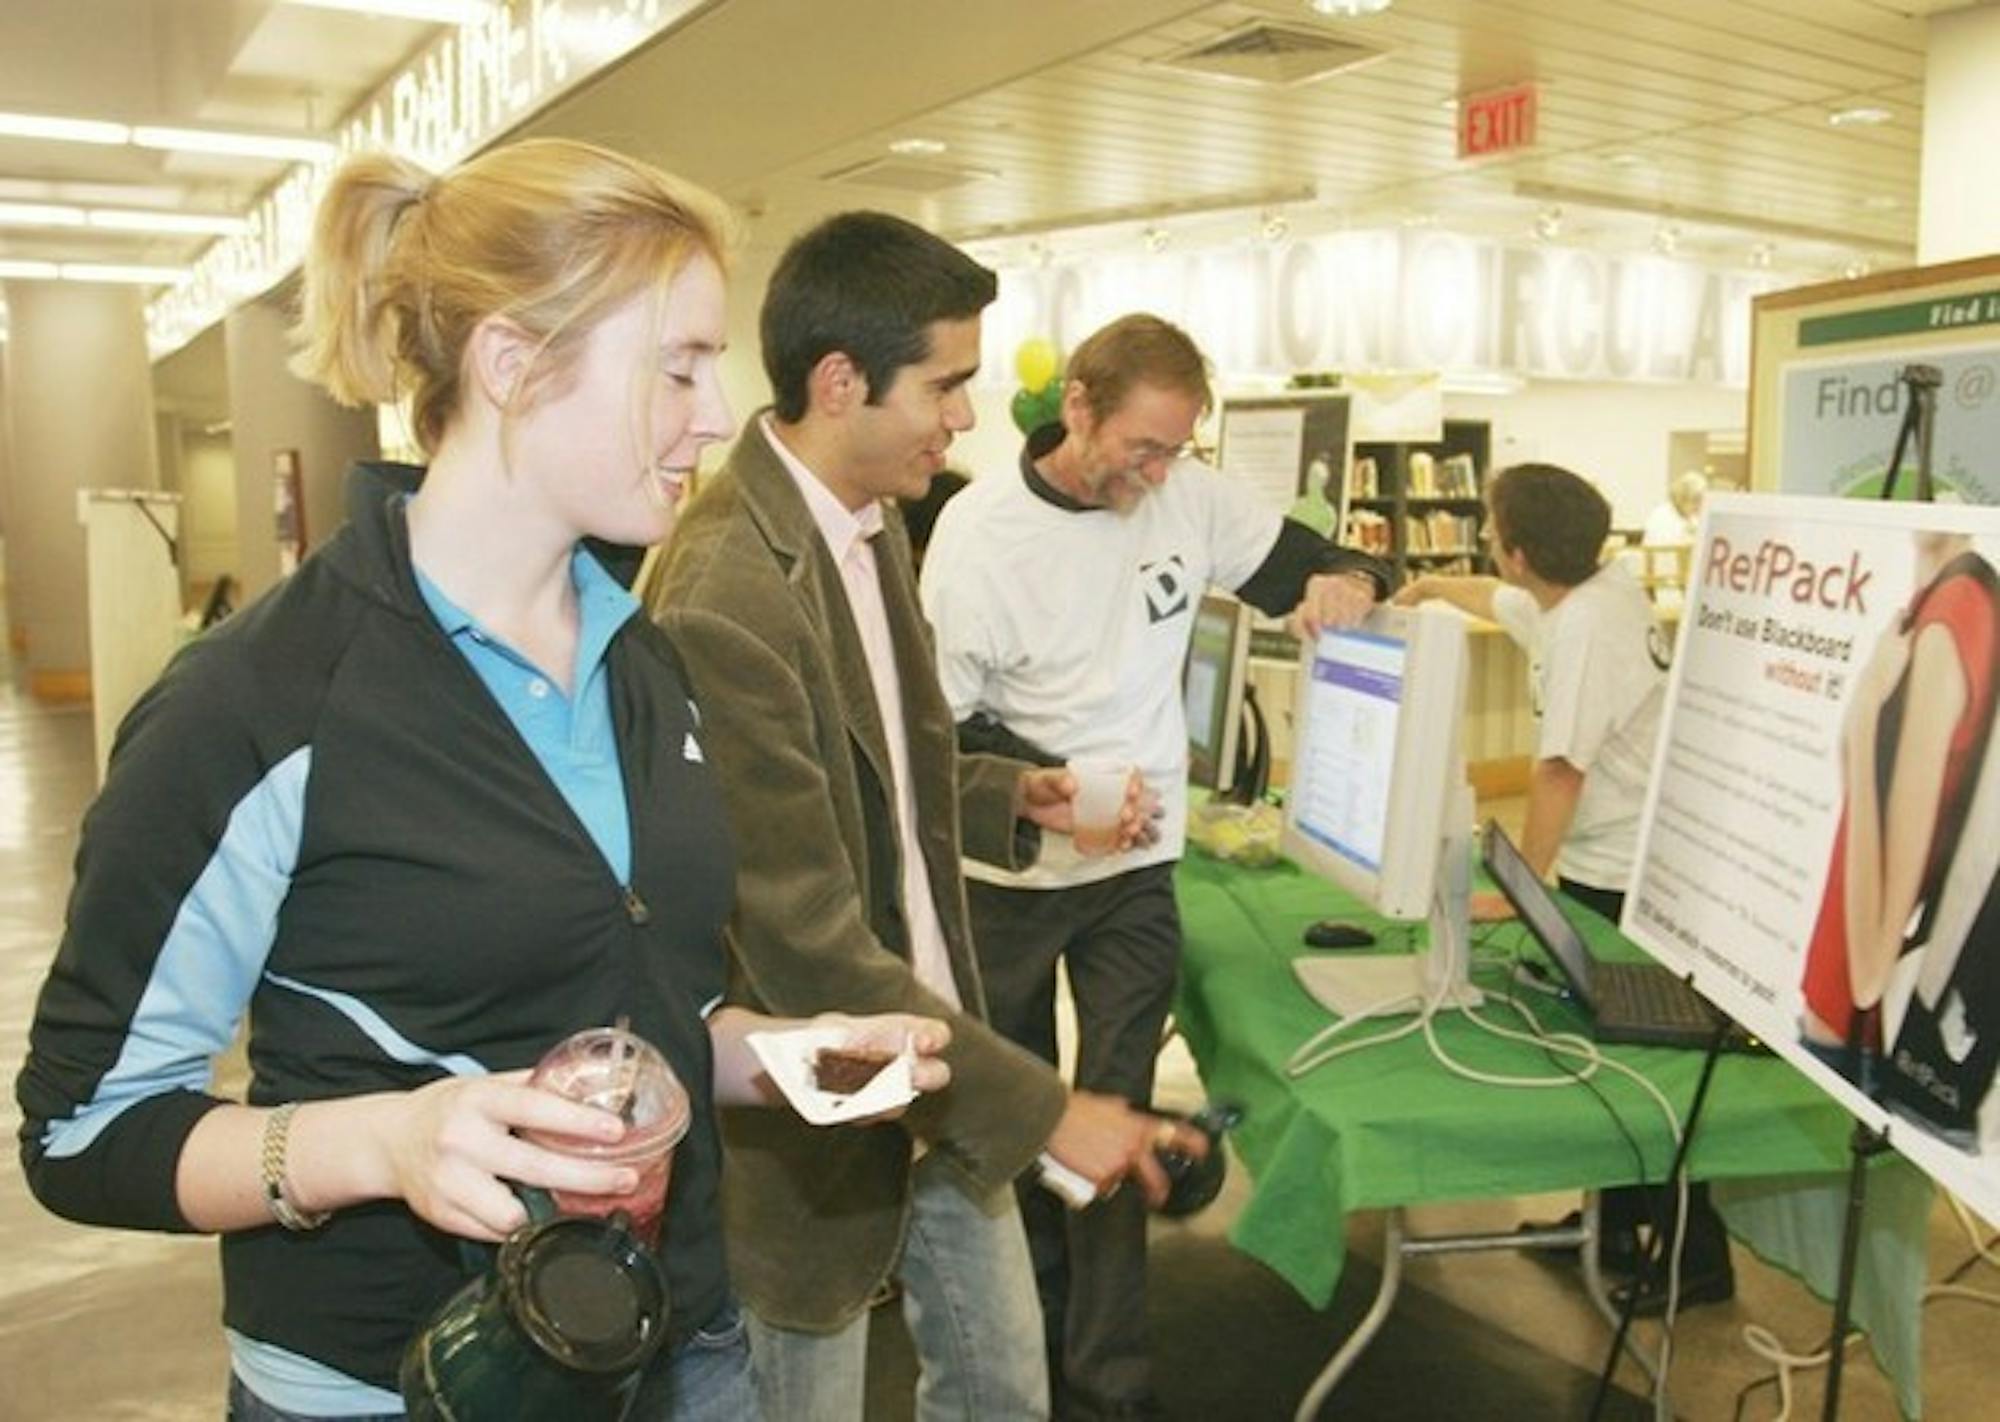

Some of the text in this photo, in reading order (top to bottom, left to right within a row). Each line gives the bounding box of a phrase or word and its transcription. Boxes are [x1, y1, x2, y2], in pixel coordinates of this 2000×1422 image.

[1467, 95, 1526, 153] EXIT
[1930, 299, 1980, 326] Find
[1816, 370, 1900, 419] Find
[1705, 535, 1872, 614] RefPack
[1698, 602, 1852, 661] Don't use Blackboard
[1765, 659, 1822, 693] without
